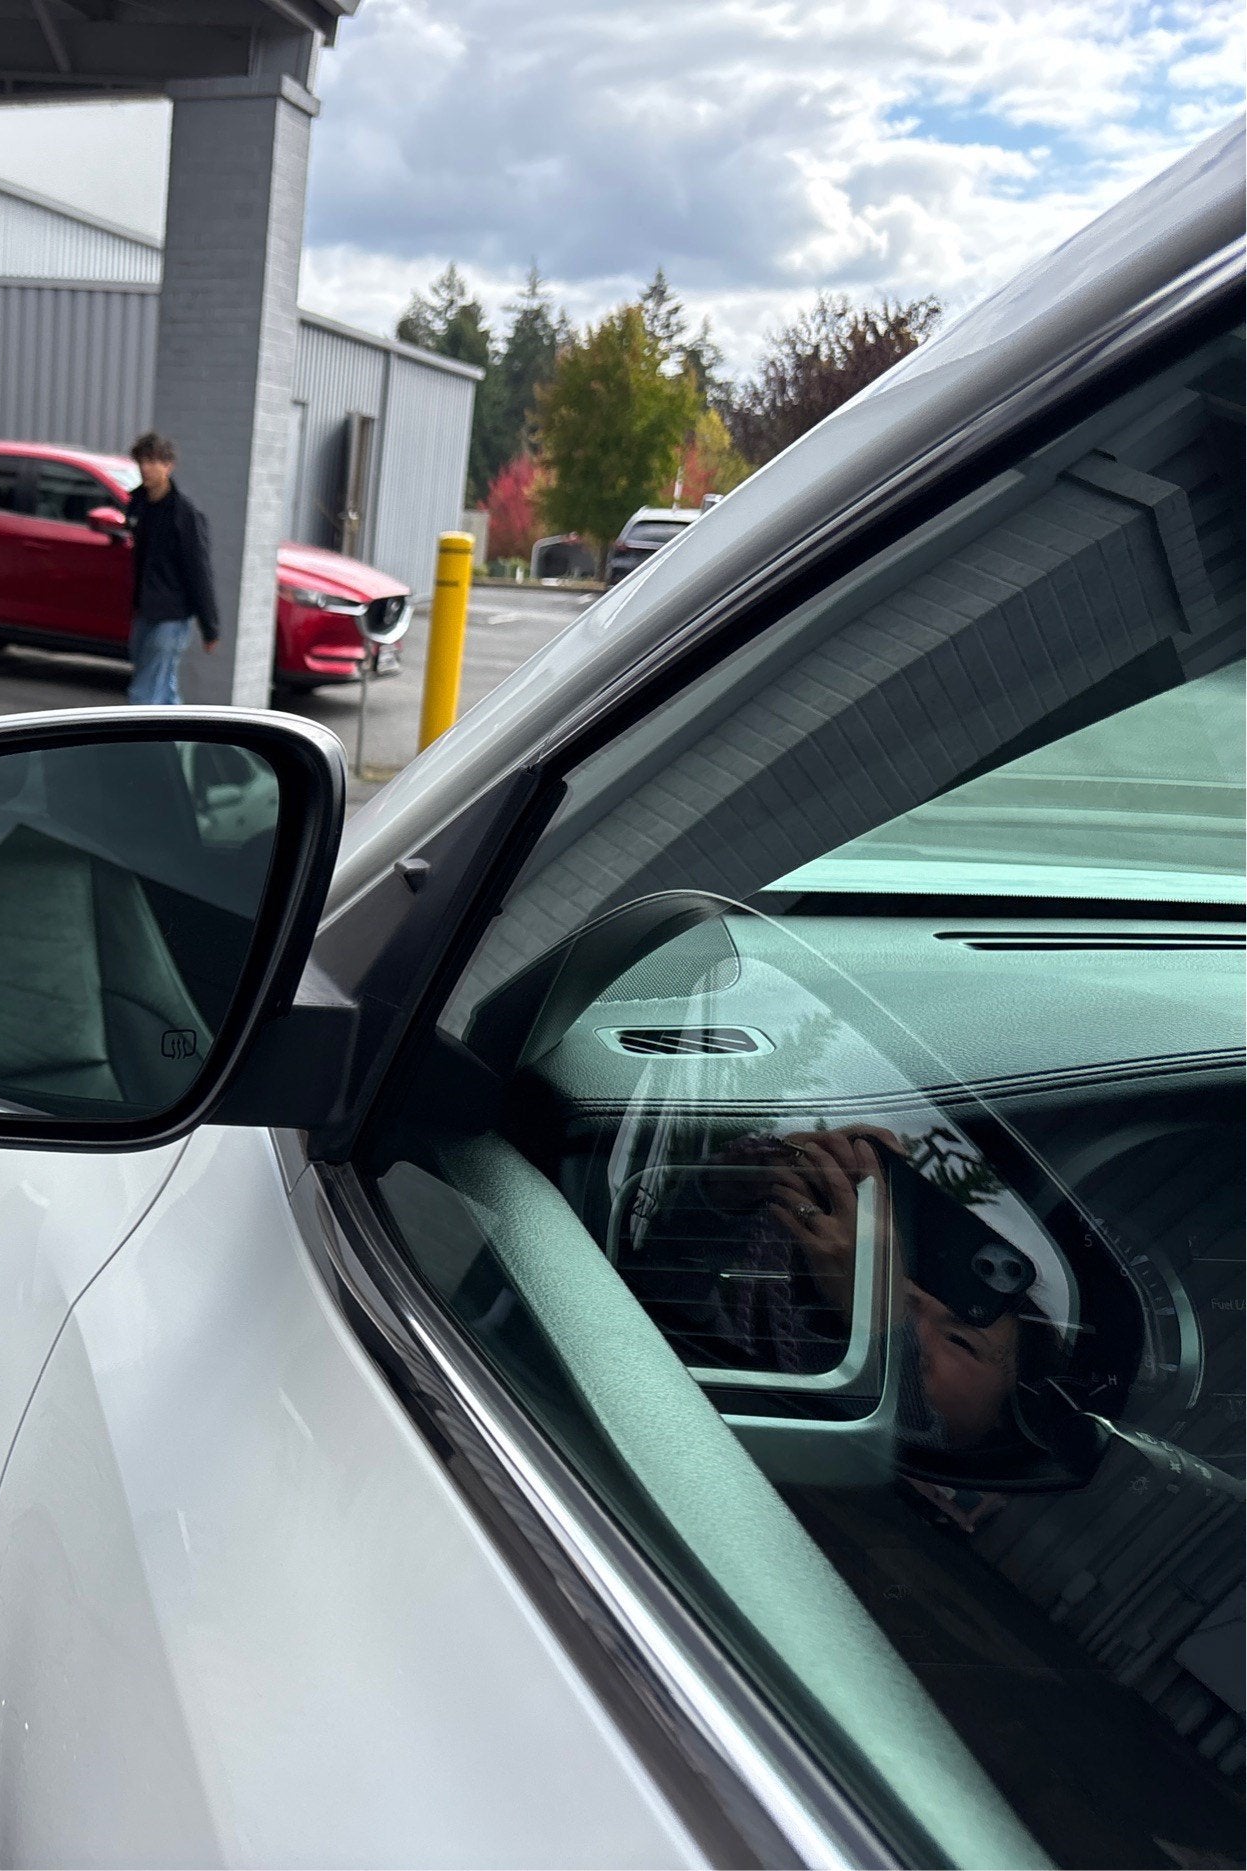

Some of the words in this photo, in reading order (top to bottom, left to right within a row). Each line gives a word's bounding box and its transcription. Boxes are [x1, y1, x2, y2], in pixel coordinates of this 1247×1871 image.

[1084, 1233, 1093, 1248] 5
[1211, 1298, 1233, 1309] Fuel
[1108, 1375, 1117, 1385] H
